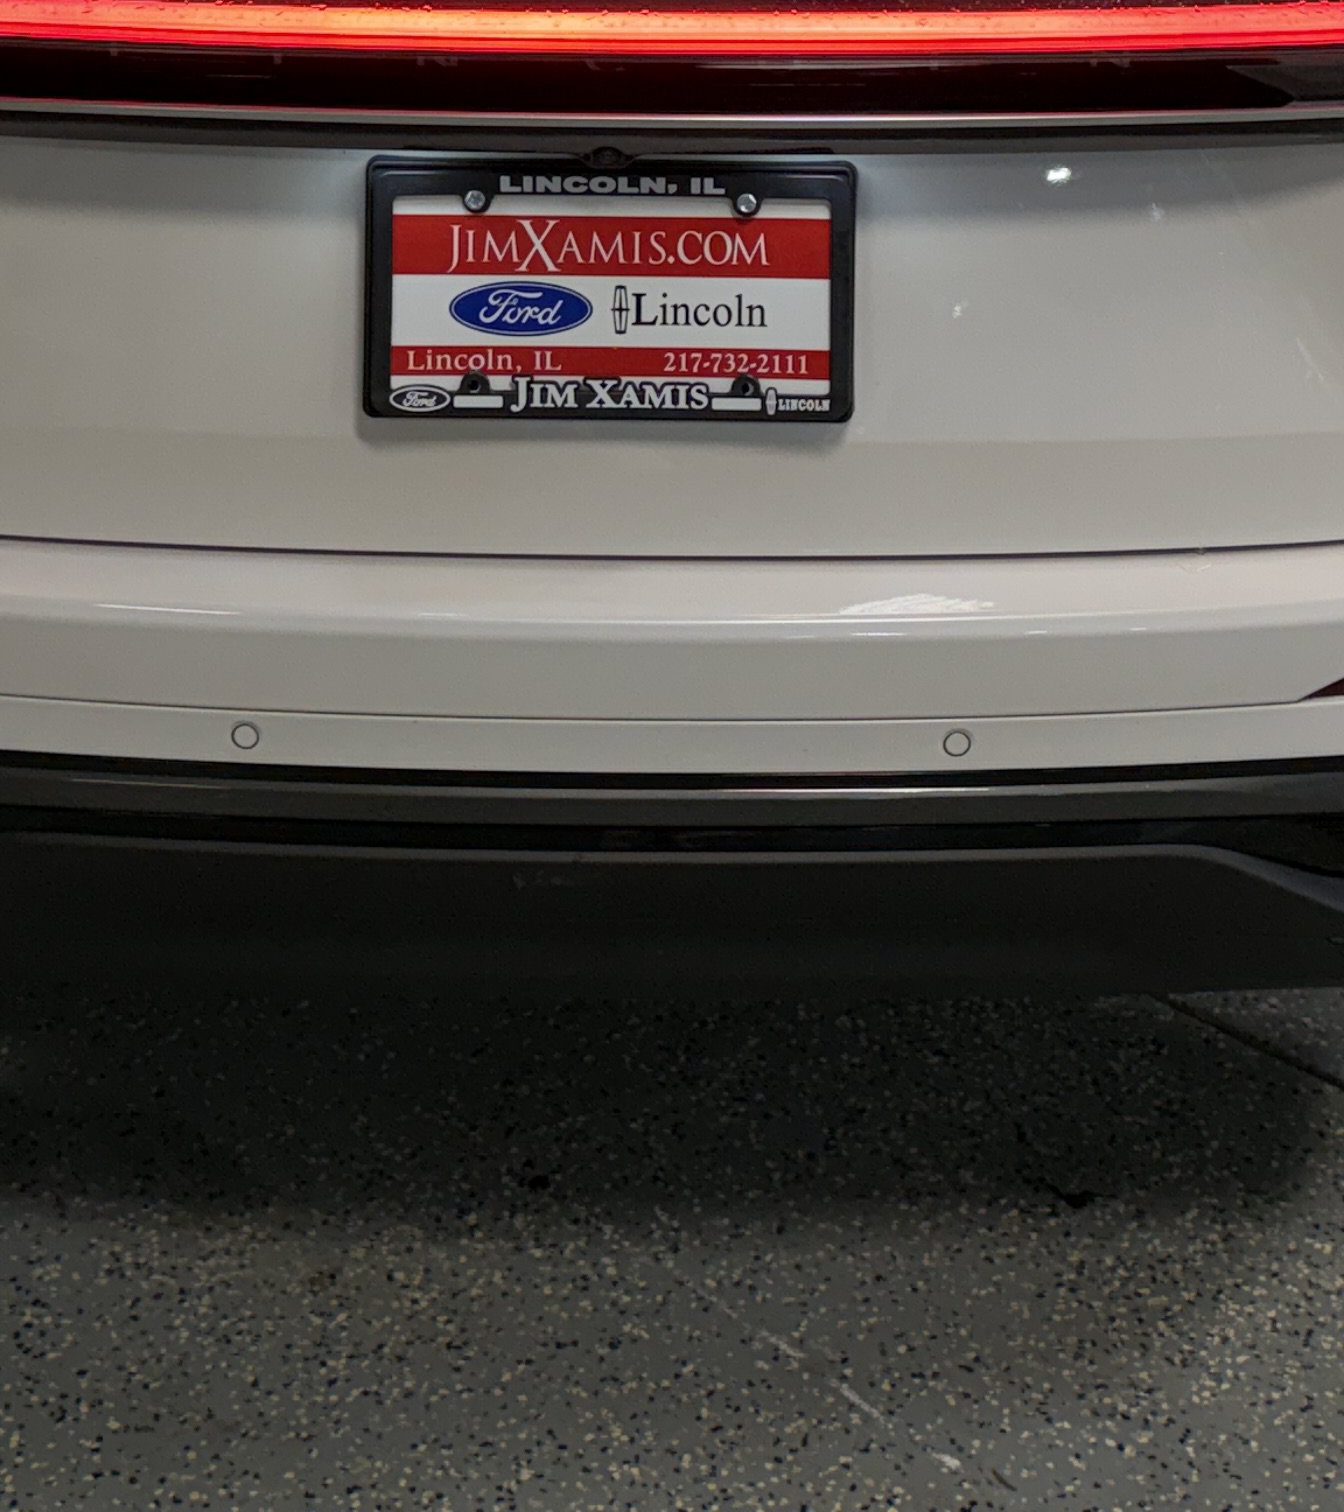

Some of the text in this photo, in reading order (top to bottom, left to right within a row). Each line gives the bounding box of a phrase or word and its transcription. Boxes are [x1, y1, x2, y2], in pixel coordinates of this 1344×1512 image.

[500, 175, 726, 195] LINCOLN, IL
[479, 289, 561, 326] Ford
[632, 293, 768, 327] Lincoln
[407, 349, 562, 373] Lincoln, IL
[663, 352, 809, 375] 217-732-2111
[402, 391, 437, 408] Ford
[510, 376, 709, 413] JIM XAMIS
[777, 399, 831, 412] LINCOLN
